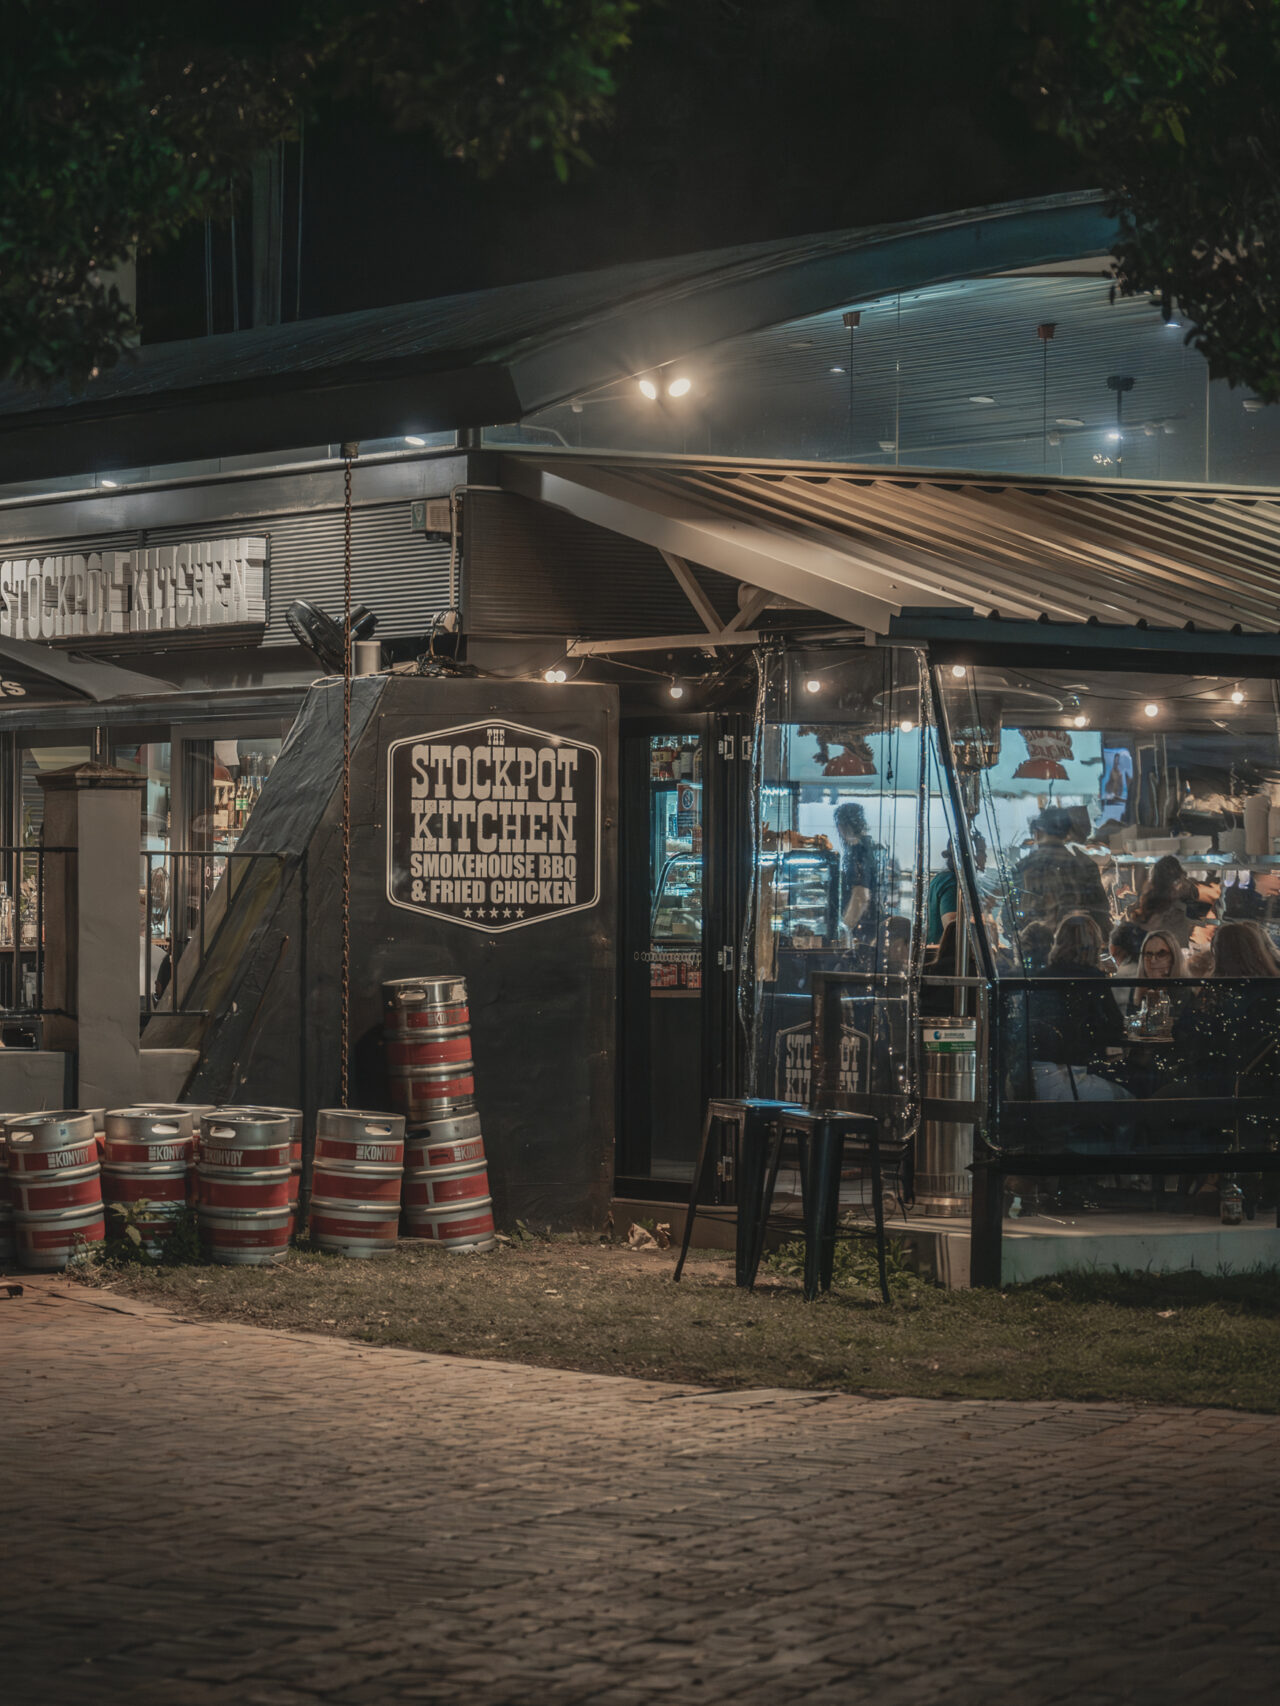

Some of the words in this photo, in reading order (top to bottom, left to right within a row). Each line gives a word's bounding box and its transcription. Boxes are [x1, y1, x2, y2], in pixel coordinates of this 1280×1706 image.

[0, 551, 130, 640] STOCKPOT
[130, 537, 267, 632] KITCHEN
[487, 729, 505, 746] THE
[411, 745, 578, 801] STOCKPOT
[411, 799, 577, 854] KITCHEN
[410, 853, 536, 878] SMOKEHOUSE
[538, 855, 577, 883] BBQ
[411, 879, 427, 902] &
[430, 880, 486, 904] FRIED
[490, 881, 577, 905] CHICKEN
[56, 1148, 89, 1168] KONVOY
[364, 1144, 397, 1161] KONVOY
